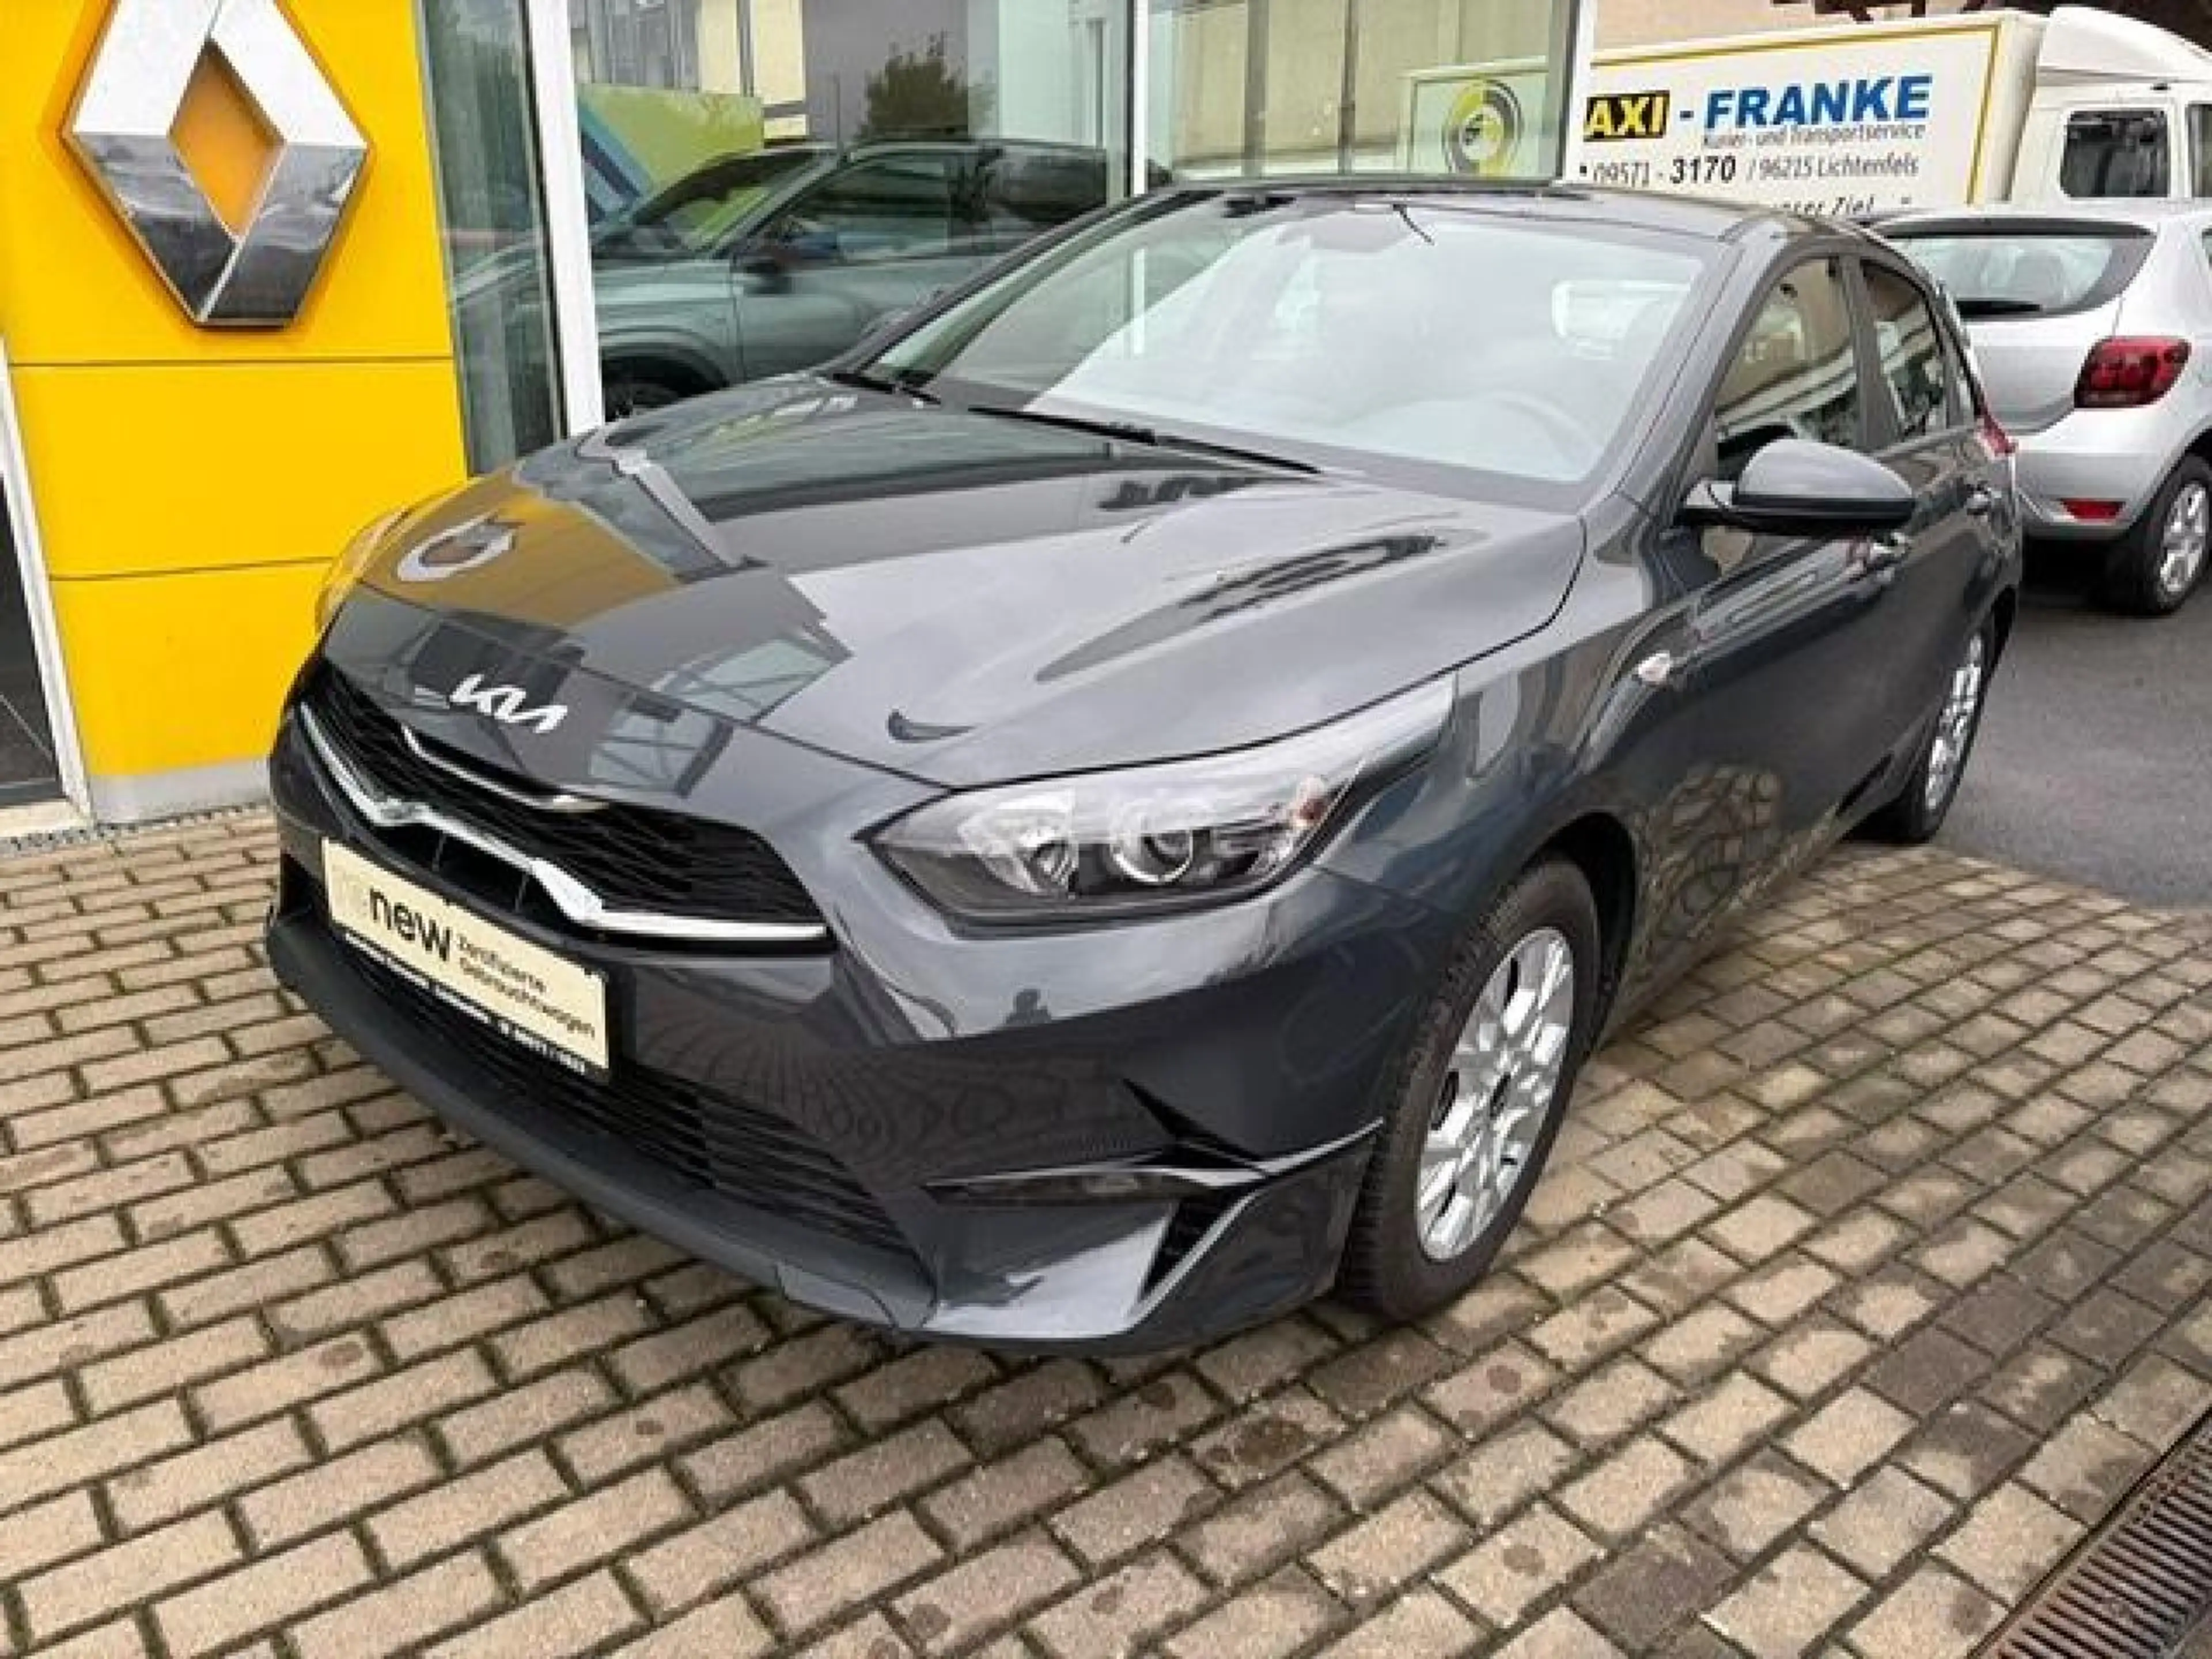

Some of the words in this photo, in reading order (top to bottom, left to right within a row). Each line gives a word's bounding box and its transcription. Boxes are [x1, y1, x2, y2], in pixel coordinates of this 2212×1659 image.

[1588, 92, 1667, 138] AXI
[1706, 75, 1932, 128] FRANKE
[1671, 154, 1736, 184] 3170
[1759, 156, 1813, 181] 96215
[1817, 152, 1919, 177] Lichtenfels
[1756, 130, 1785, 146] und
[449, 673, 568, 734] KIA
[369, 888, 452, 962] new
